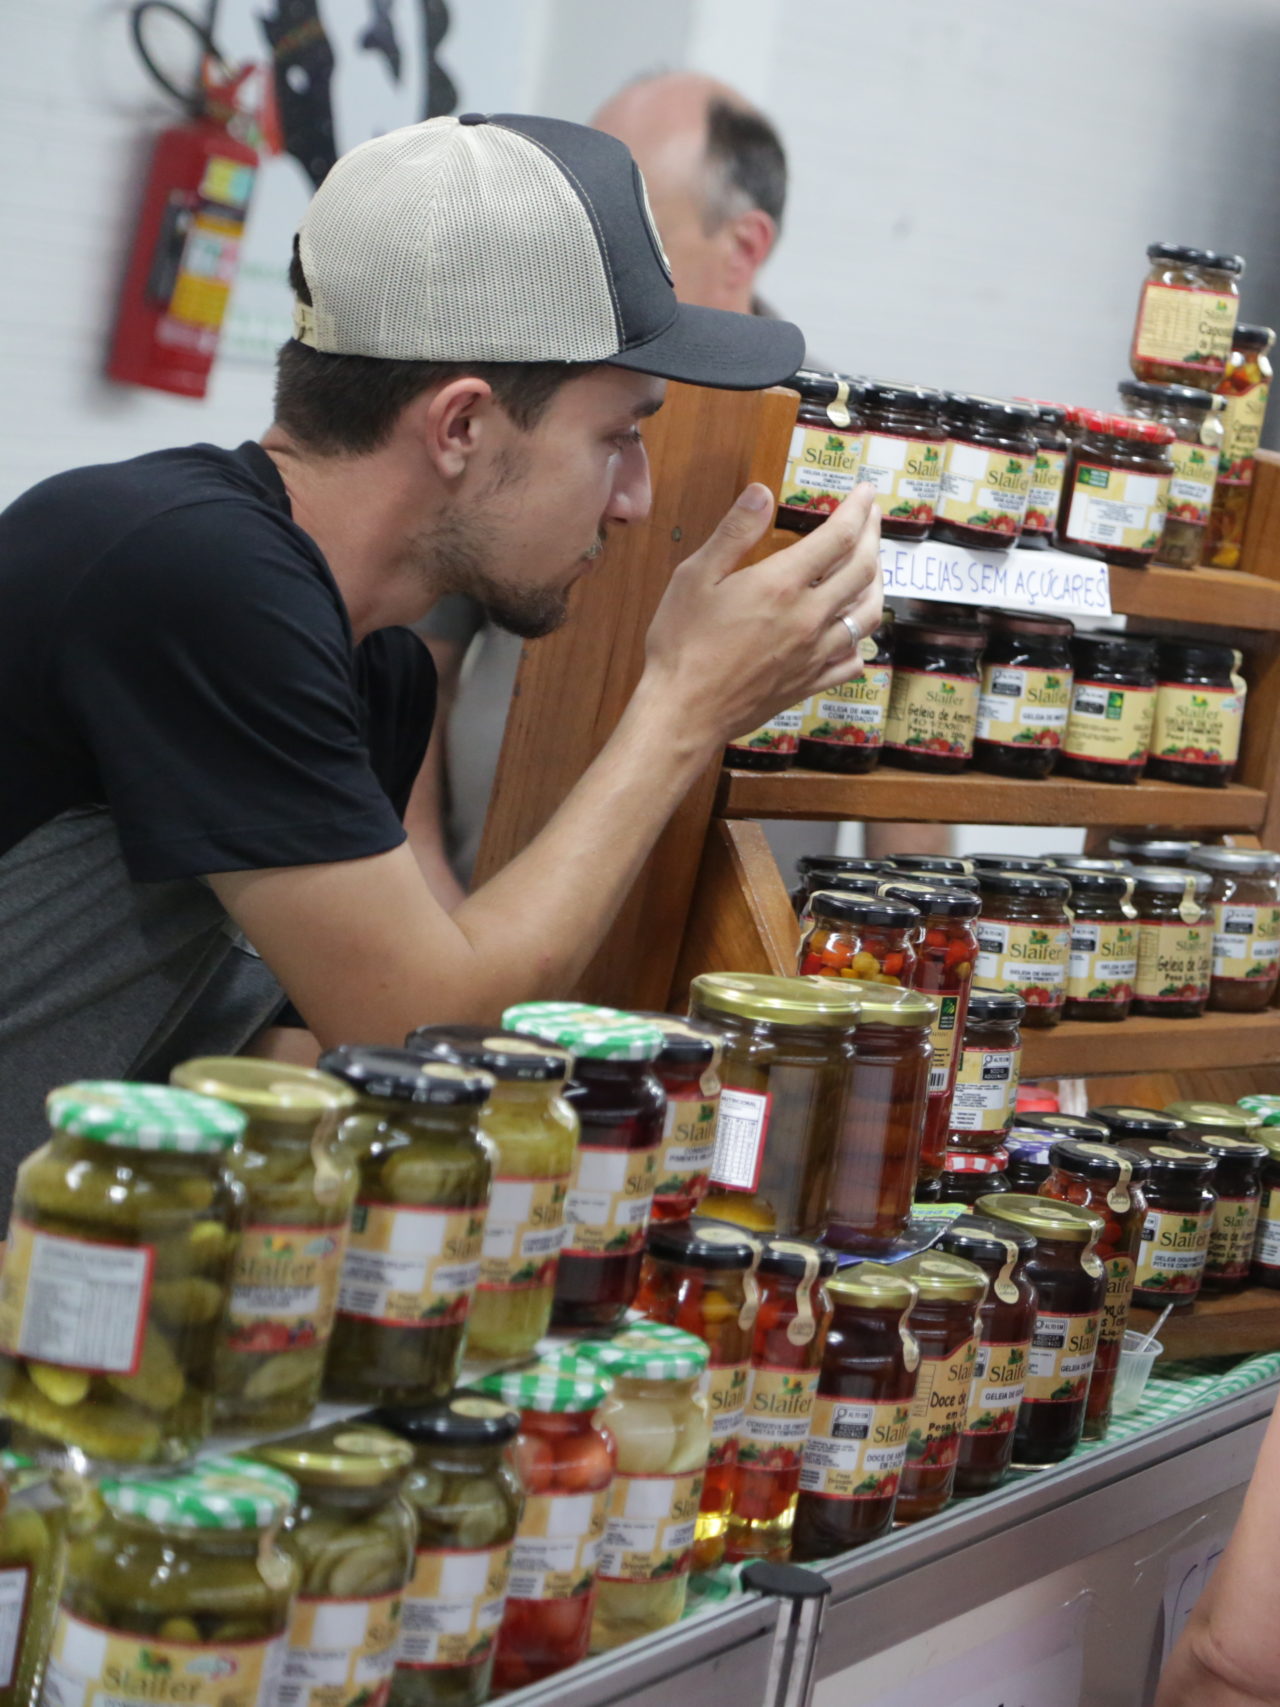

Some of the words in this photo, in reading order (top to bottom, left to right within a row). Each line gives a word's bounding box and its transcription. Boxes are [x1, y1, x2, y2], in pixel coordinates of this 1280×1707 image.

[804, 447, 855, 471] Slaifer
[880, 549, 964, 593] GELEIAS
[968, 561, 1008, 596] SEM
[825, 683, 880, 701] Slaifer
[822, 703, 848, 714] GELEIA
[1009, 943, 1062, 961] Slaifer
[1060, 1364, 1080, 1373] GELEIA
[753, 1392, 813, 1413] Slaifer
[930, 1391, 956, 1408] Doce
[985, 1391, 1007, 1401] GELEIA
[1008, 1390, 1014, 1399] DE
[867, 1453, 885, 1463] DOCE
[886, 1453, 894, 1461] DE
